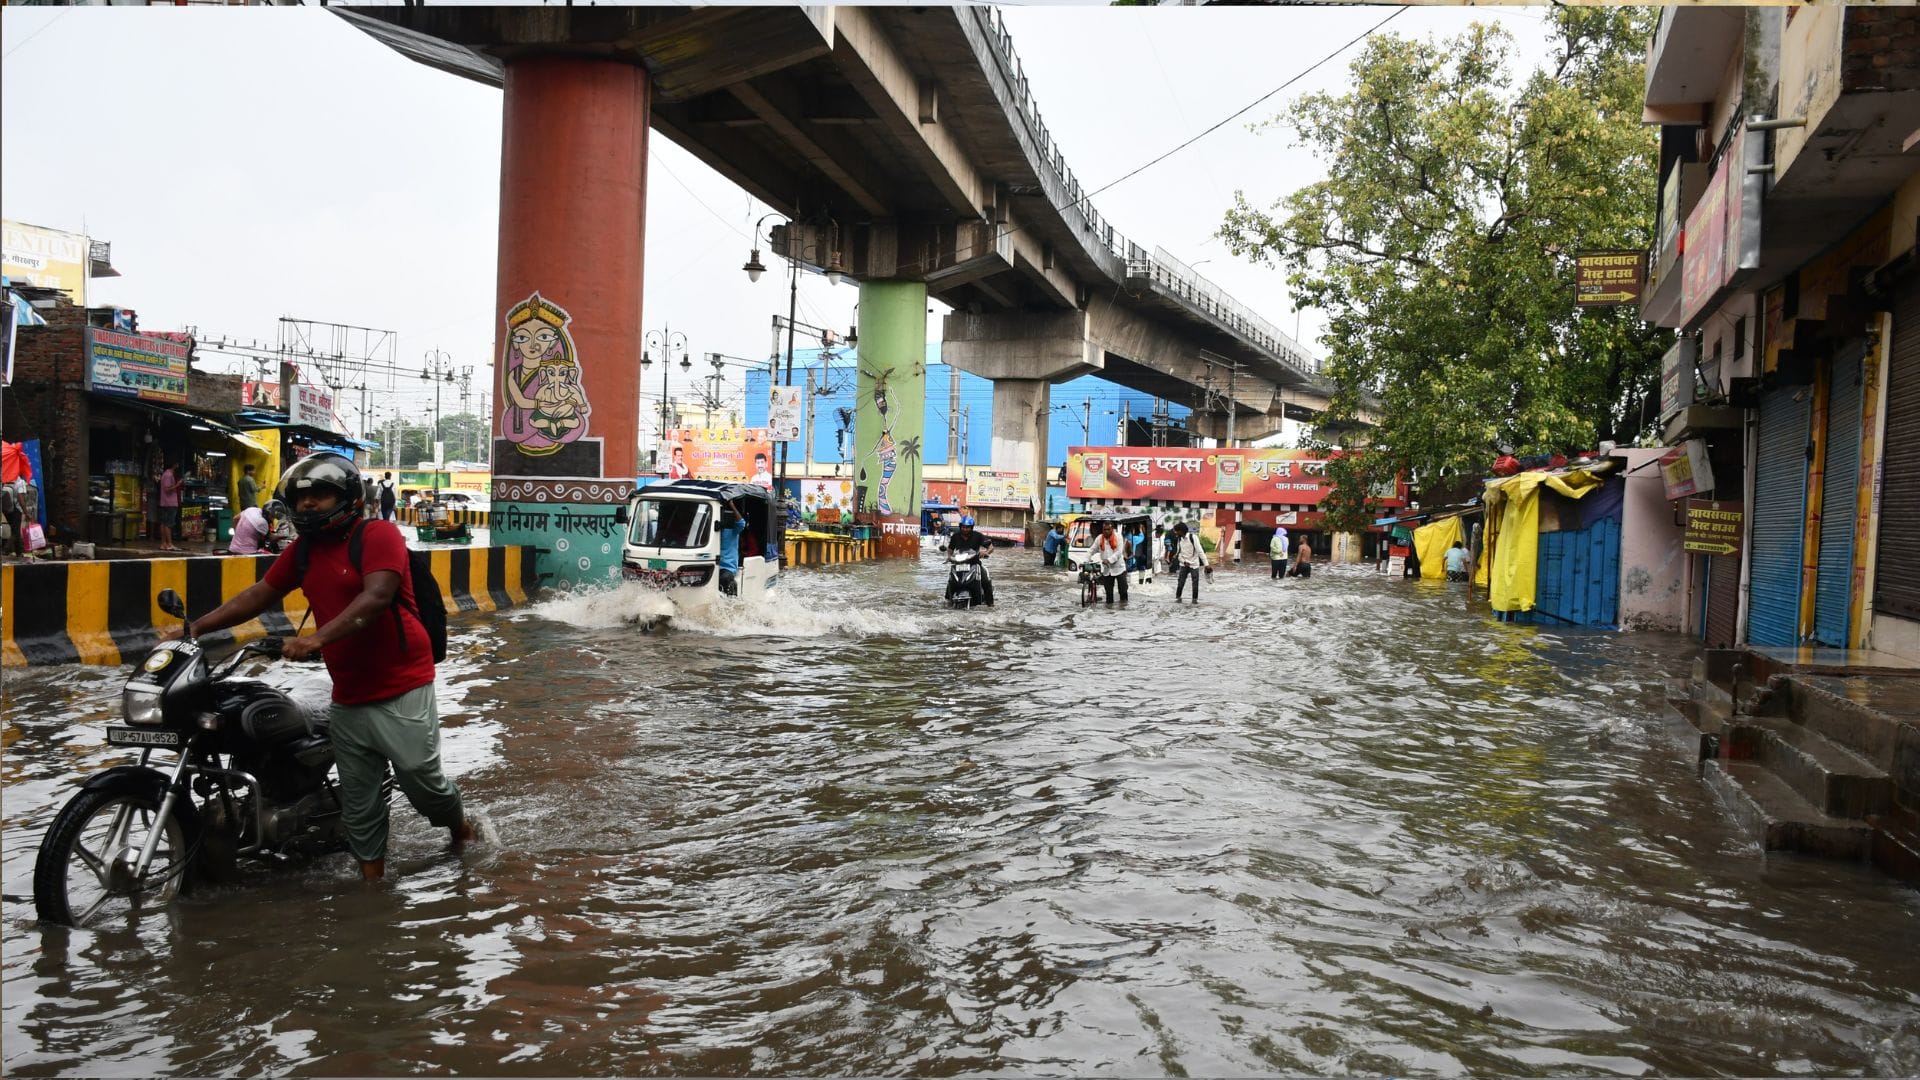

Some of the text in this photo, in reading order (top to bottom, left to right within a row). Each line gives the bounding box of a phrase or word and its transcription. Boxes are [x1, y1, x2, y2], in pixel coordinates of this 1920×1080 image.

[1578, 255, 1639, 266] जायसवाल
[1606, 269, 1633, 278] हाउस
[1110, 456, 1204, 477] शुद्ध प्लस
[1248, 459, 1328, 480] शुद्ध प्ल
[1293, 483, 1318, 491] मसाला
[1688, 509, 1742, 521] जायसवाल
[507, 505, 550, 532] निगम
[554, 506, 618, 538] गोरखपुर
[1712, 523, 1736, 532] हाउस
